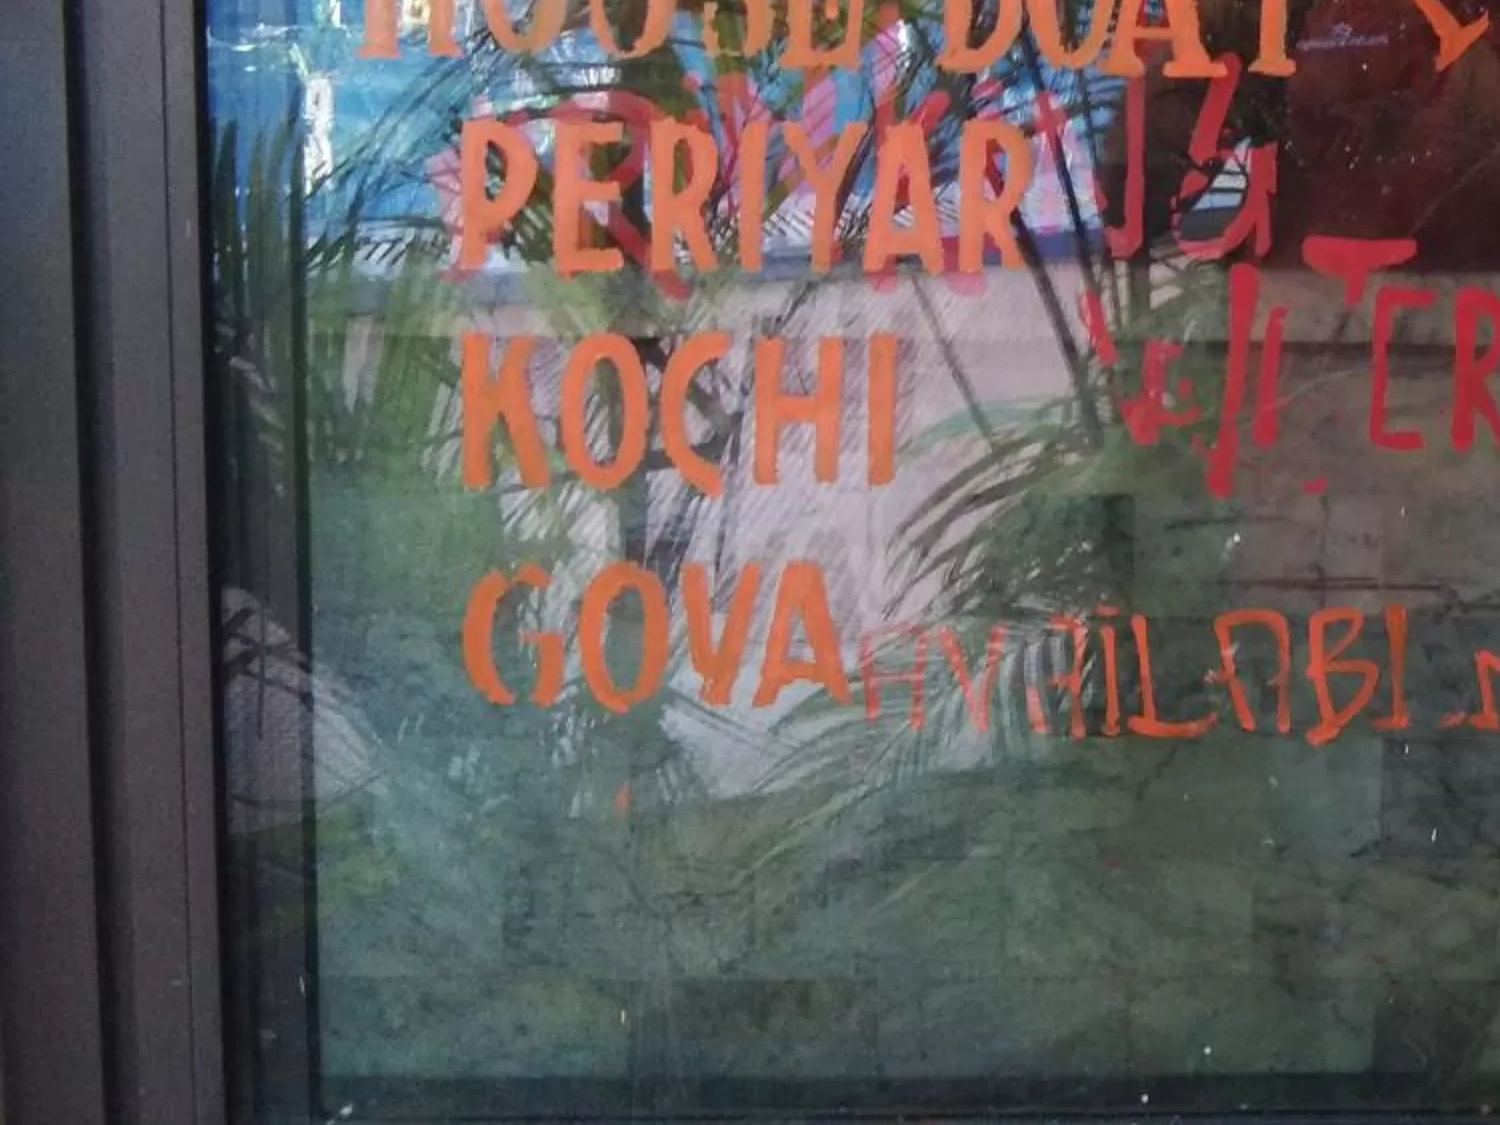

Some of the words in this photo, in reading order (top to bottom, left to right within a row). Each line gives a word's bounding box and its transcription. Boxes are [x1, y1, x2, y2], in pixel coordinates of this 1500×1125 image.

[456, 117, 1035, 278] PERIYAR
[460, 330, 899, 499] KOCHI
[461, 558, 853, 715] GOVA
